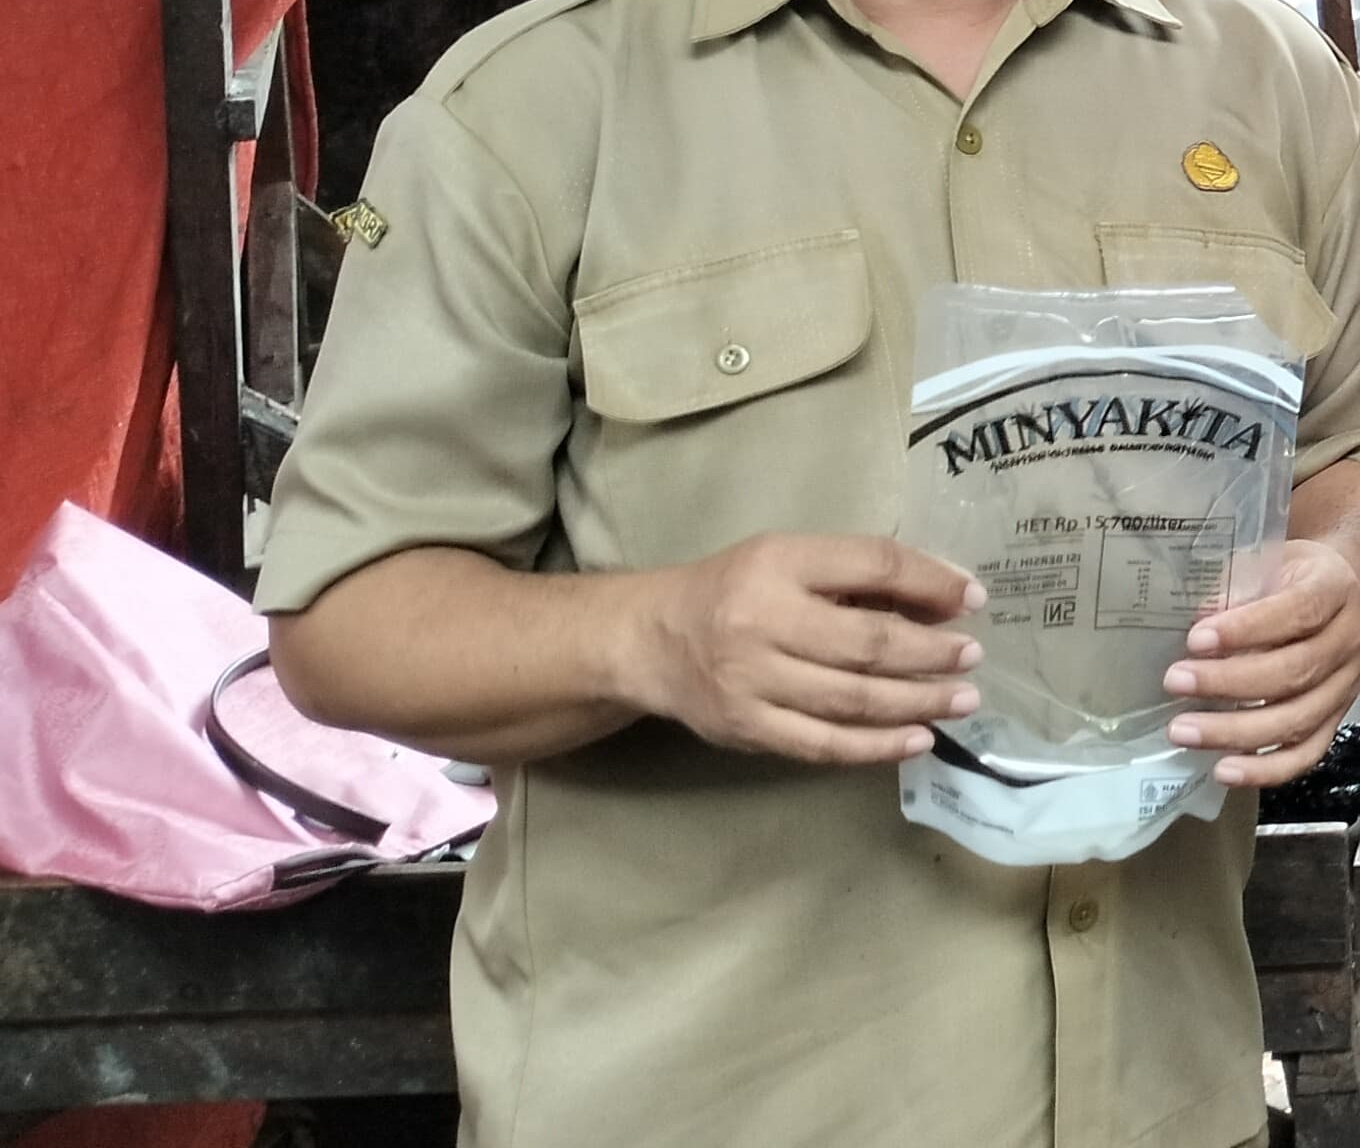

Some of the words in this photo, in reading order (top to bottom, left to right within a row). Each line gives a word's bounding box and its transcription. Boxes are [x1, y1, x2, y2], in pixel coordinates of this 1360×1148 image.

[937, 395, 1266, 477] MINYAKITA
[1016, 516, 1050, 535] HET
[1054, 517, 1079, 533] Rp
